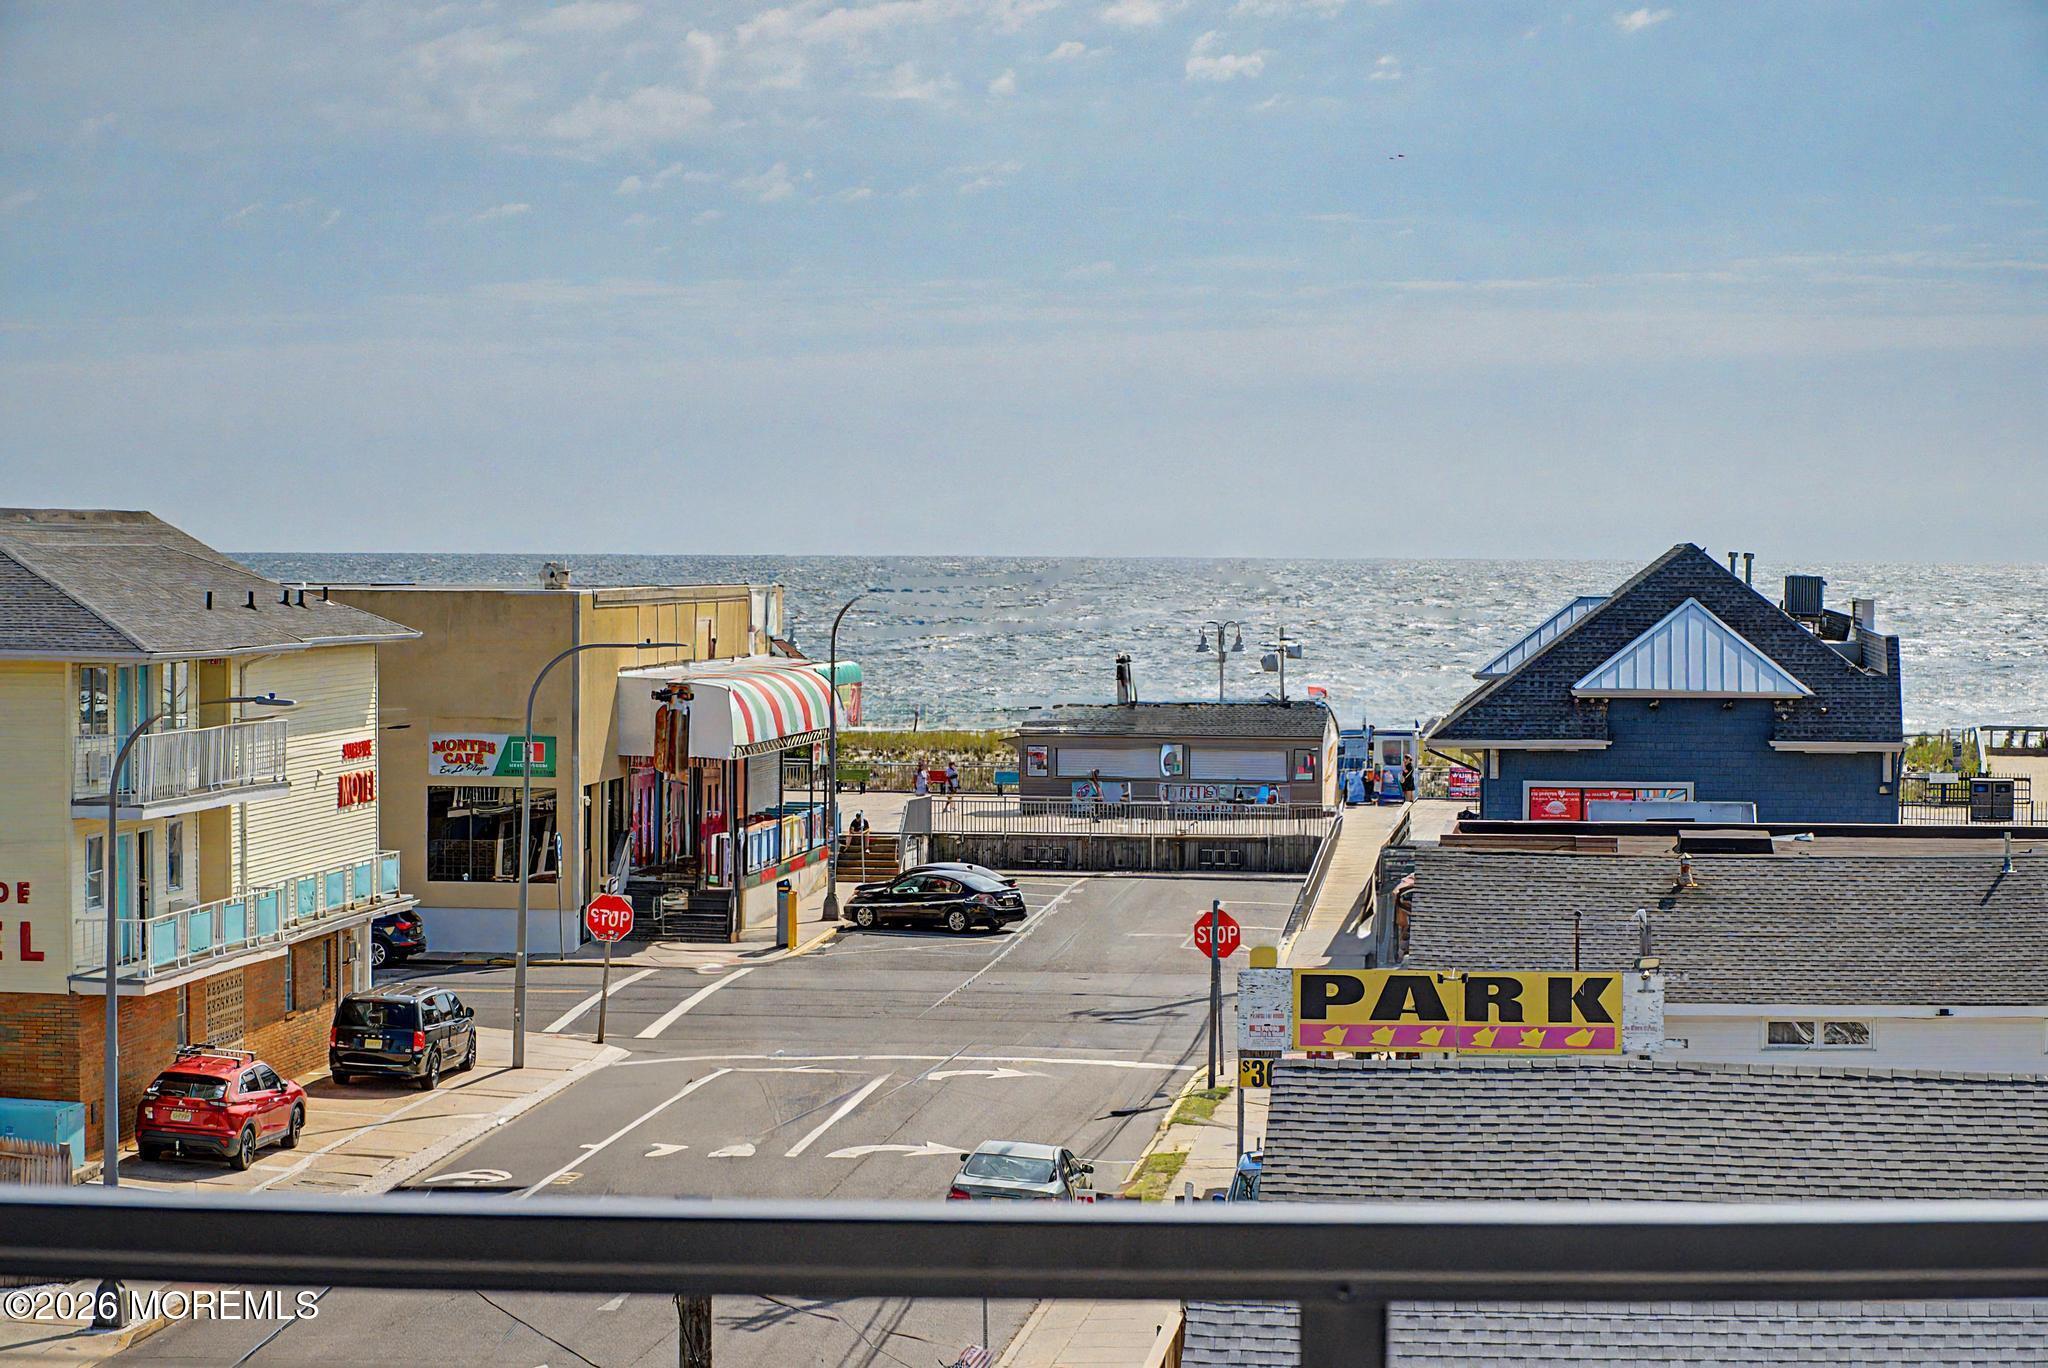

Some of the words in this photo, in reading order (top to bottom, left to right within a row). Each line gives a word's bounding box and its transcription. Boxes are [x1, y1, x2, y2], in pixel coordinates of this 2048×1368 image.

[591, 908, 630, 928] STOP
[1197, 925, 1238, 944] STOP
[1300, 974, 1614, 1023] PARK
